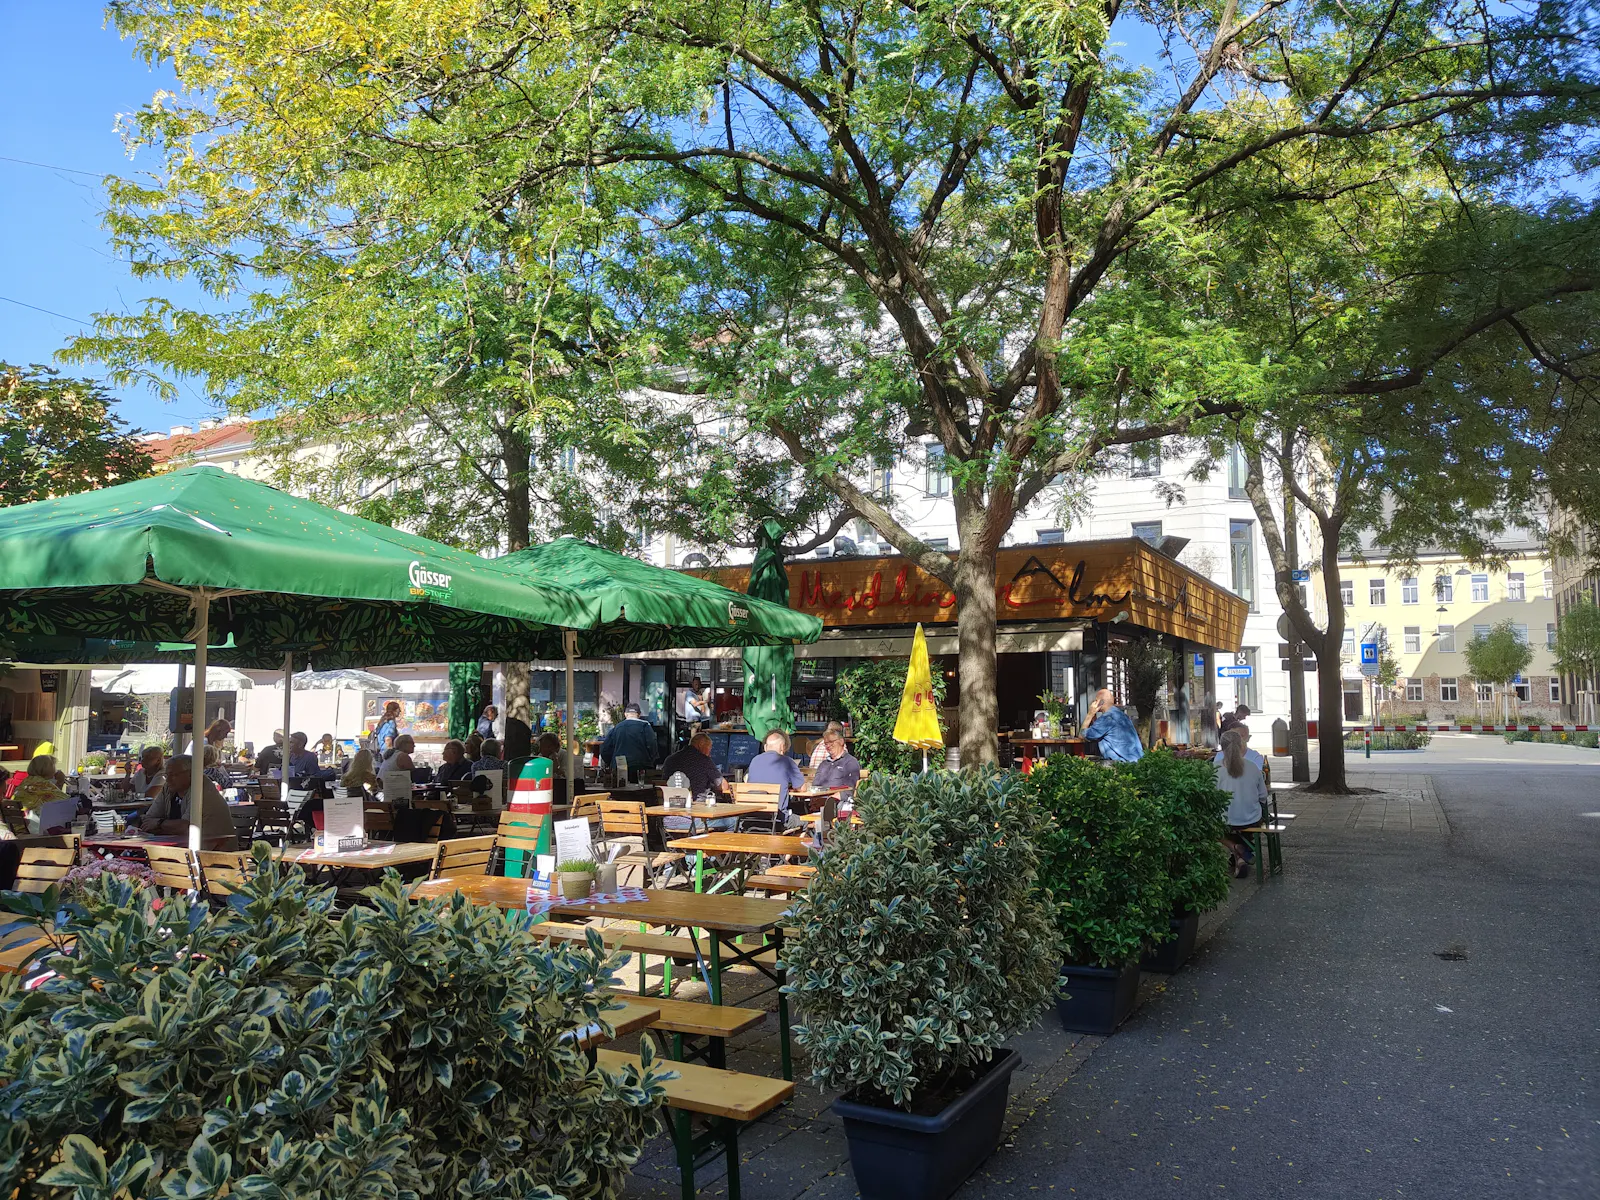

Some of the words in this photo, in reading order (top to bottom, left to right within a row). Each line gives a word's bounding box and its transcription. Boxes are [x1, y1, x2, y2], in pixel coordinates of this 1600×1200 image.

[408, 560, 452, 589] Gösser
[1012, 556, 1131, 607] Alm
[409, 588, 452, 600] BIOSTOFF
